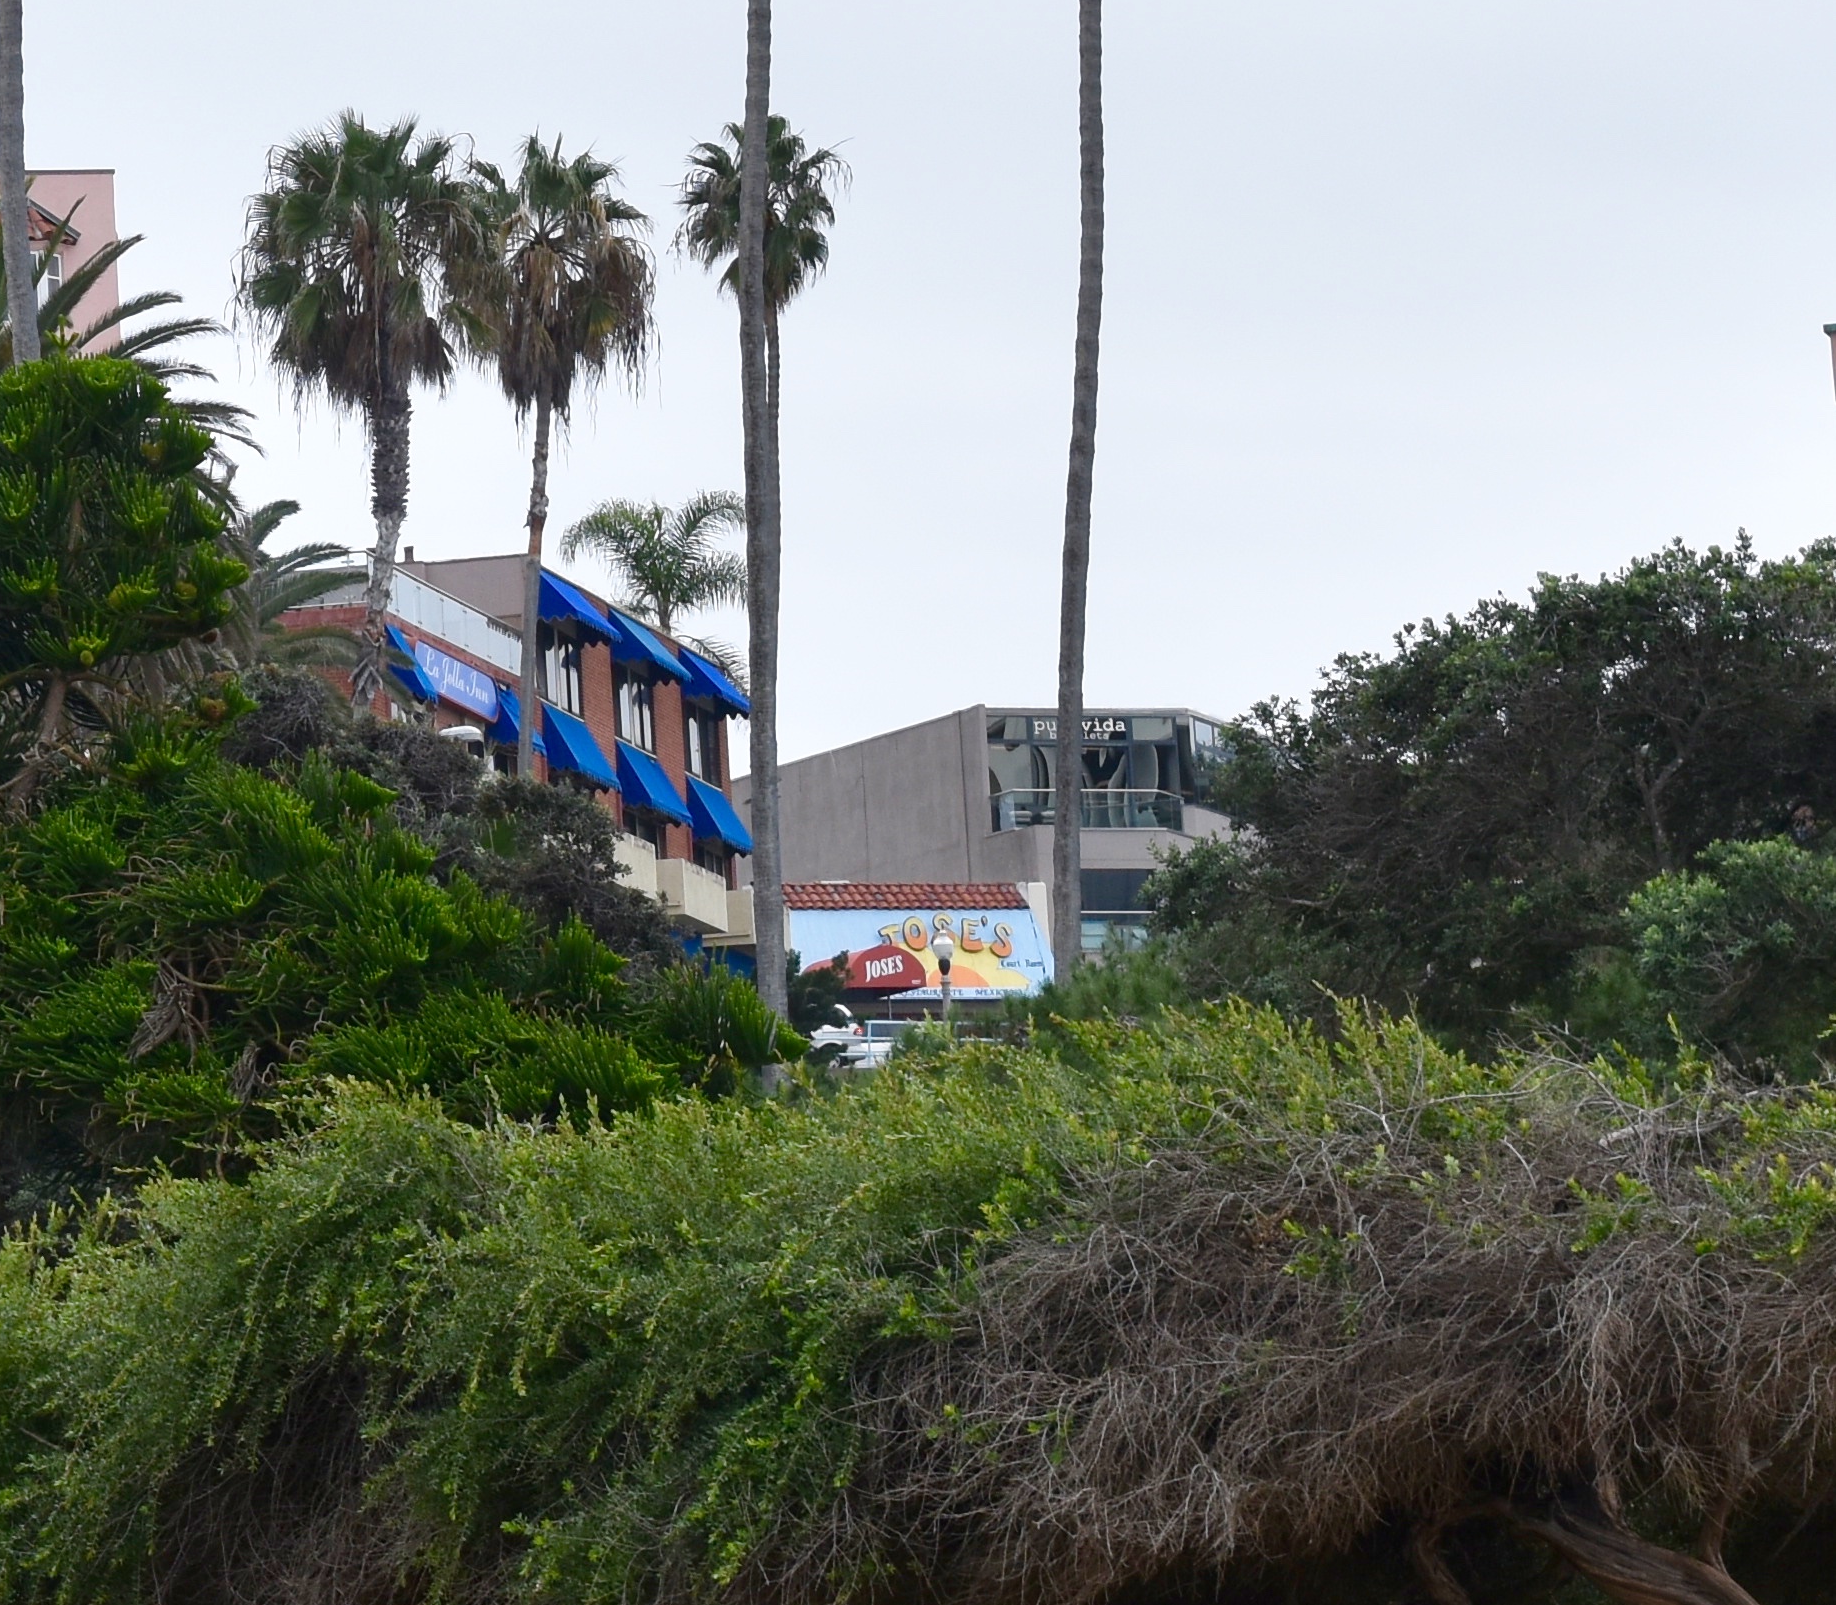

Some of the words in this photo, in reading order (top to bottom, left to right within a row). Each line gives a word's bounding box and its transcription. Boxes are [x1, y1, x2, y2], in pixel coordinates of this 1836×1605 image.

[422, 644, 439, 679] La
[440, 657, 464, 693] Jolla
[466, 669, 488, 704] Inn
[878, 912, 1013, 958] JOSE'S
